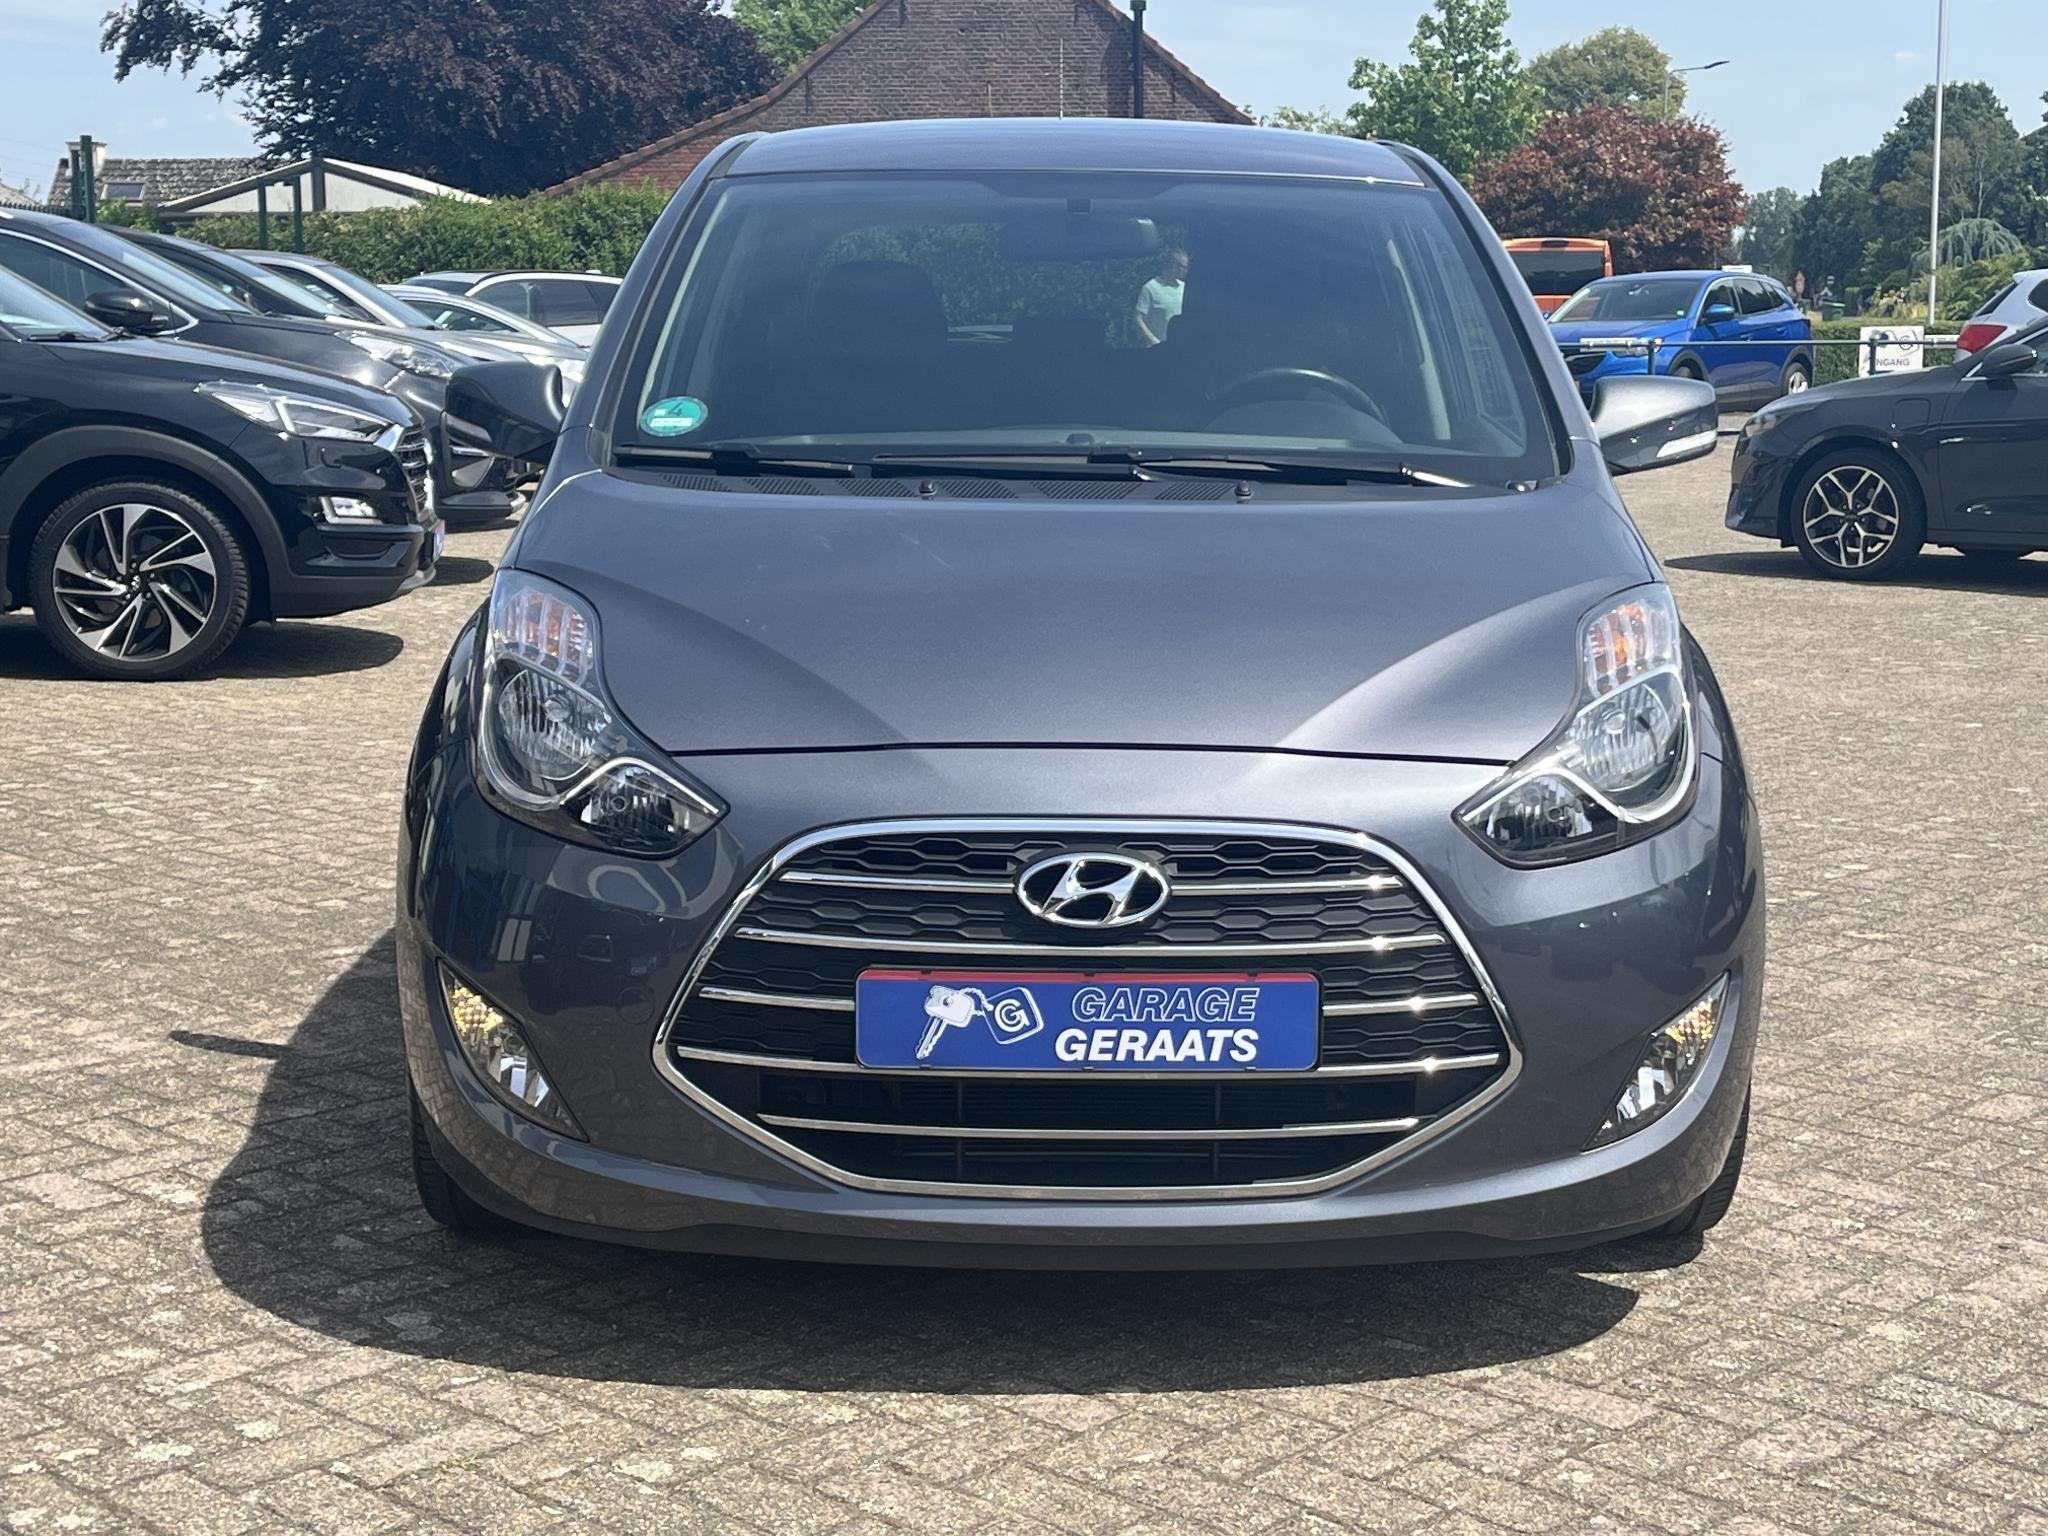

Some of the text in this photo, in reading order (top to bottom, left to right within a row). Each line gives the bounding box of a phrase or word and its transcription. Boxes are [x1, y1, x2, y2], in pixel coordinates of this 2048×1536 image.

[1875, 358, 1910, 366] NGANG
[994, 998, 1029, 1032] G
[1072, 987, 1259, 1022] GARAGE
[1055, 1029, 1258, 1062] GERAATS
